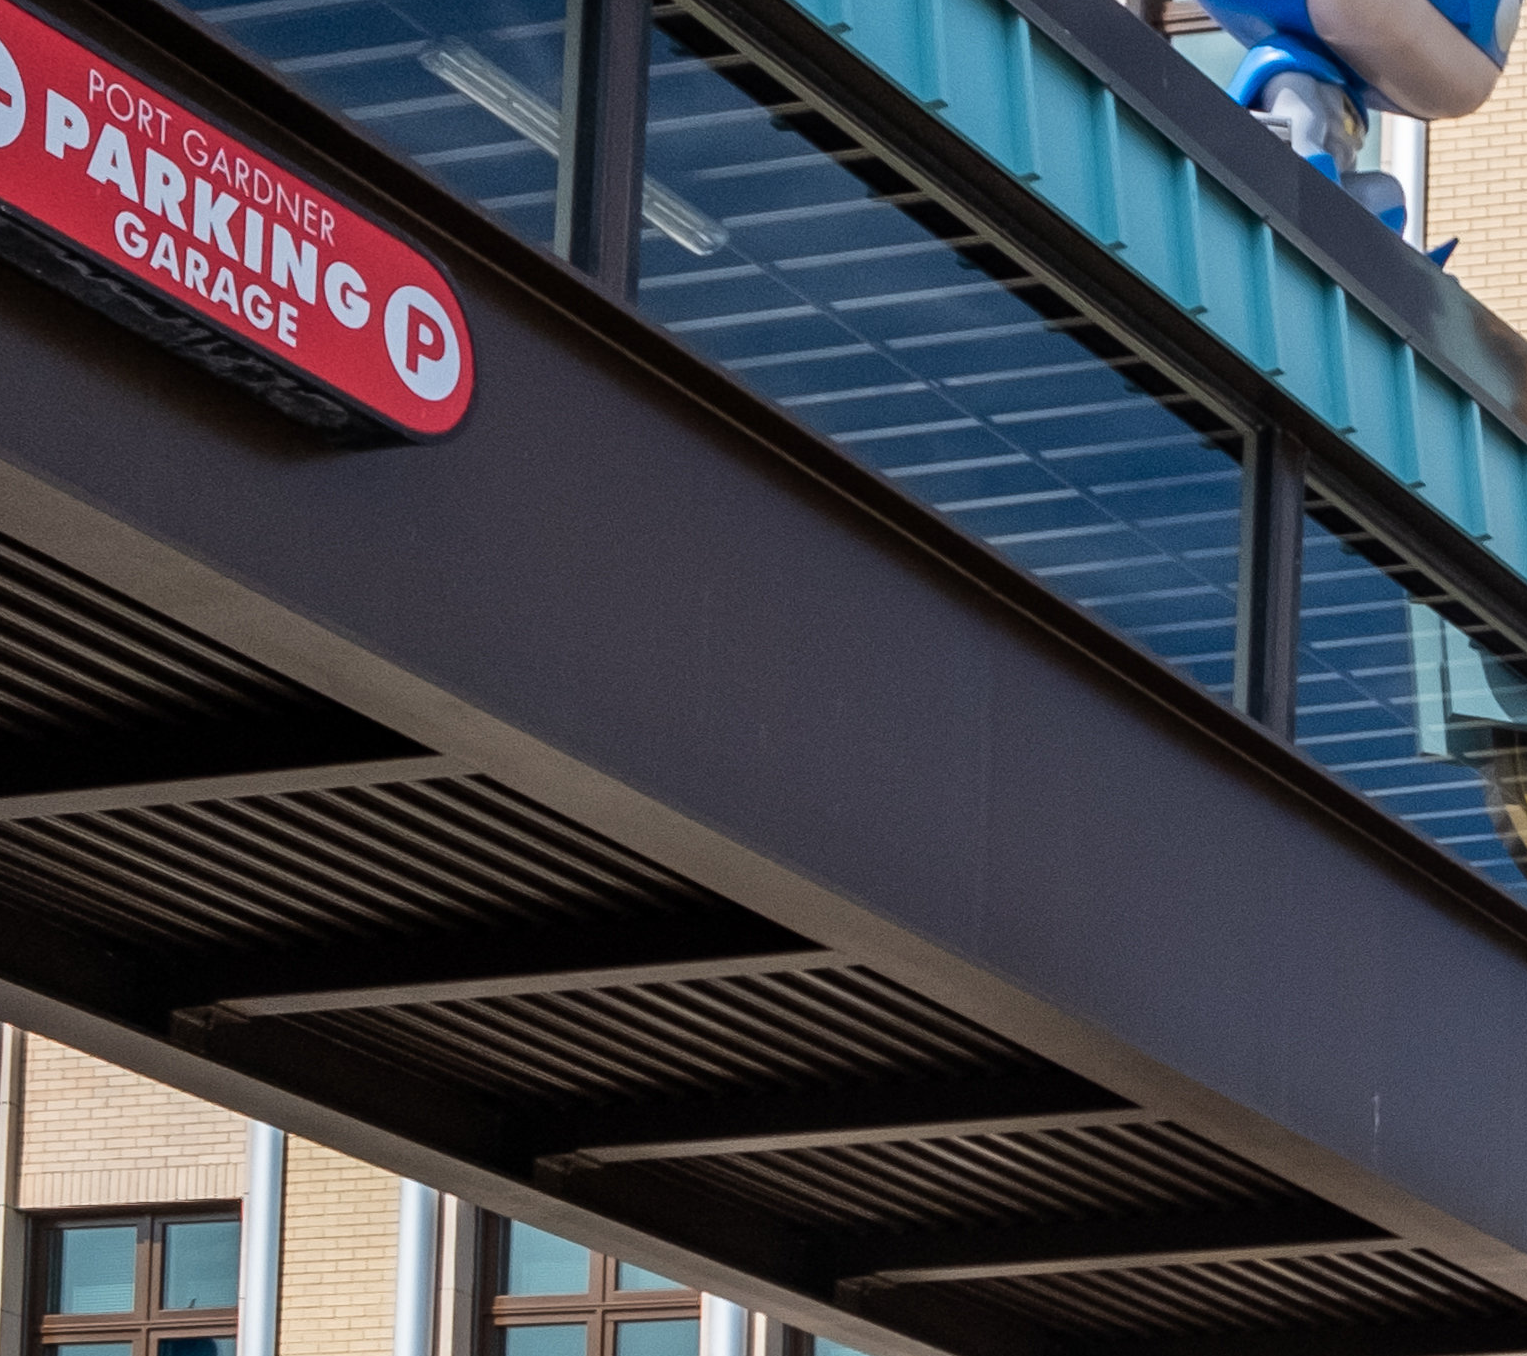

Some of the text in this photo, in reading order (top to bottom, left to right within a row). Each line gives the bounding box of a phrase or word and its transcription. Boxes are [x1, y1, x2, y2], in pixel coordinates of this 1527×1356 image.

[44, 89, 371, 330] PARKING
[88, 68, 335, 246] PORT GARDNER
[114, 211, 298, 348] GARAGE
[404, 303, 446, 375] P
